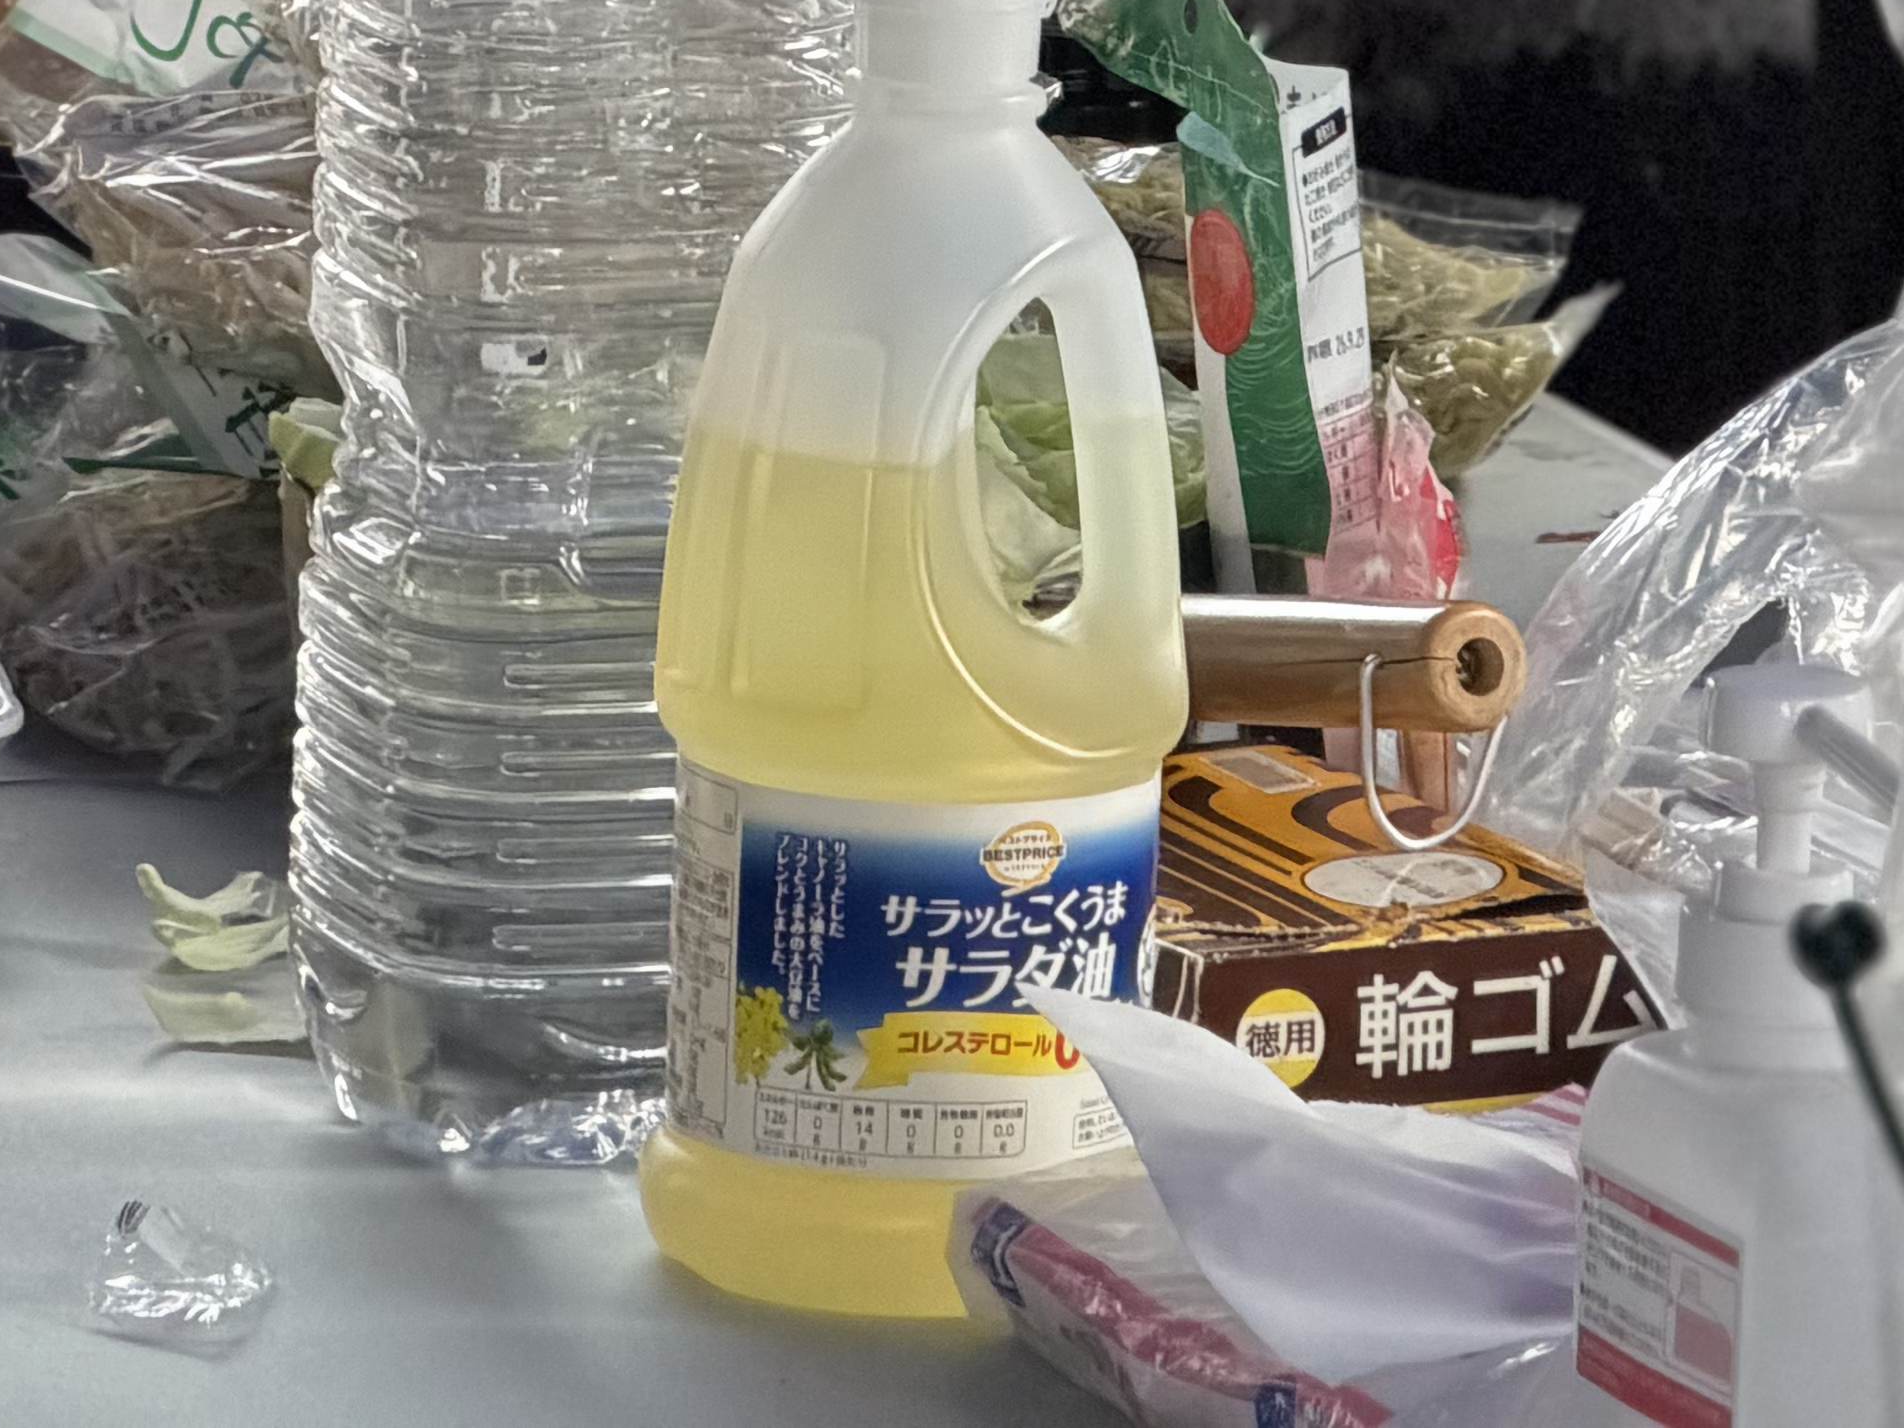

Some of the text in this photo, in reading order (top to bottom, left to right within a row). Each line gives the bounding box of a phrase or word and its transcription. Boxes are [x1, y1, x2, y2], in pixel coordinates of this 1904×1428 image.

[982, 844, 1064, 862] BESTPRICE
[881, 881, 1128, 940] サラッとこくうま
[896, 932, 1115, 1010] サラダ油
[1245, 1019, 1318, 1060] 徳用
[1355, 955, 1667, 1079] 輪ゴム
[856, 1121, 874, 1135] 14
